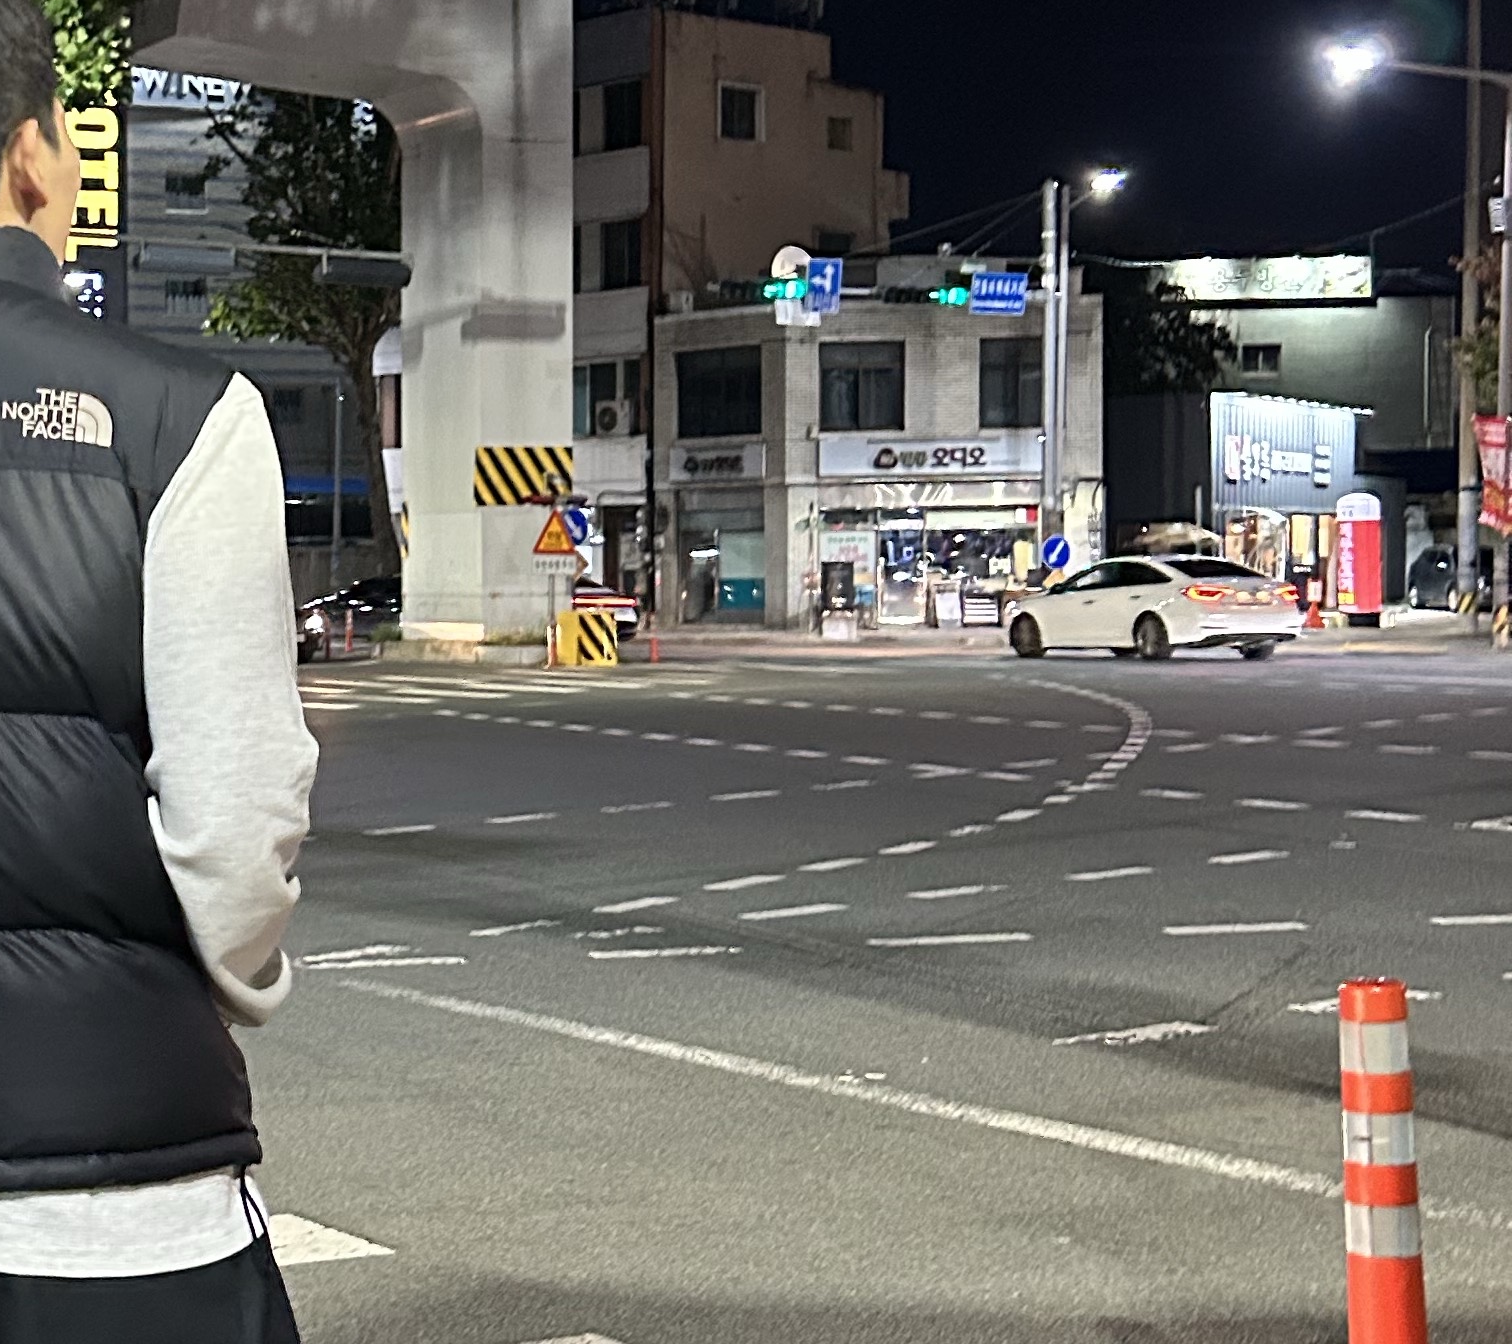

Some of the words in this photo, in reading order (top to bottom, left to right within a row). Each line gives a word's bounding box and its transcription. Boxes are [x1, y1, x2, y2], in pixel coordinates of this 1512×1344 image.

[65, 90, 119, 262] OTEL
[36, 387, 79, 408] THE
[1, 401, 77, 425] NORTH
[22, 420, 76, 441] FACE
